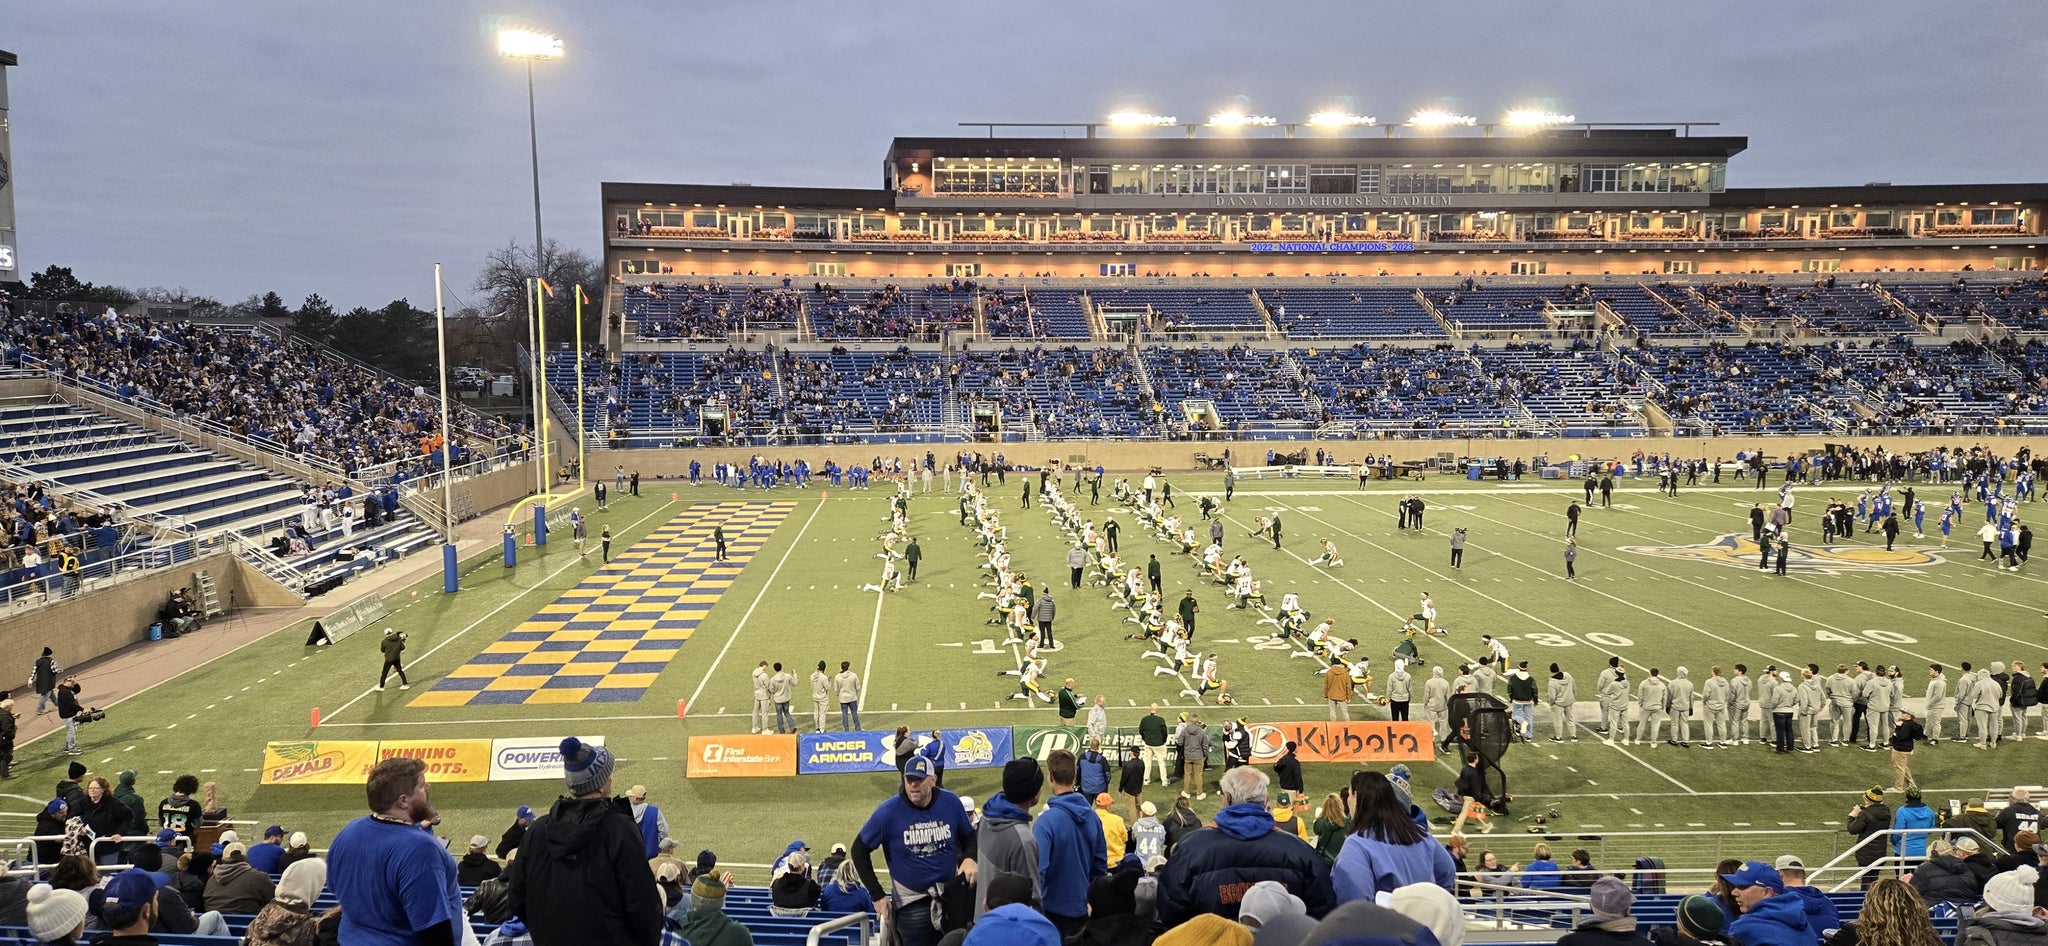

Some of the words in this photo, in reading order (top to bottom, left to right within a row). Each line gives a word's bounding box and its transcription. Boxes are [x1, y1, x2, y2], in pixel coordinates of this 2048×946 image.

[1216, 196, 1258, 206] DANA
[1265, 196, 1278, 206] J.
[1287, 196, 1373, 206] DYKHOUSE
[1381, 196, 1452, 206] STADIUM
[1251, 243, 1273, 251] 2022
[1279, 243, 1327, 251] NATIONAL
[1329, 243, 1387, 251] CHAMPIONS
[1392, 243, 1414, 251] 2023
[1524, 633, 1634, 647] 30
[1815, 630, 1918, 644] 40
[815, 740, 866, 752] UNDER
[1296, 726, 1419, 755] Kubota
[382, 748, 456, 760] WINNING
[725, 748, 745, 756] First
[808, 752, 873, 764] ARMOUR
[723, 755, 763, 763] Interstate
[763, 755, 781, 763] Bank
[272, 757, 332, 781] DEKALB
[163, 813, 187, 832] 18
[2018, 821, 2038, 833] 44
[903, 823, 952, 846] CHAMPIONS
[1139, 837, 1158, 855] 44
